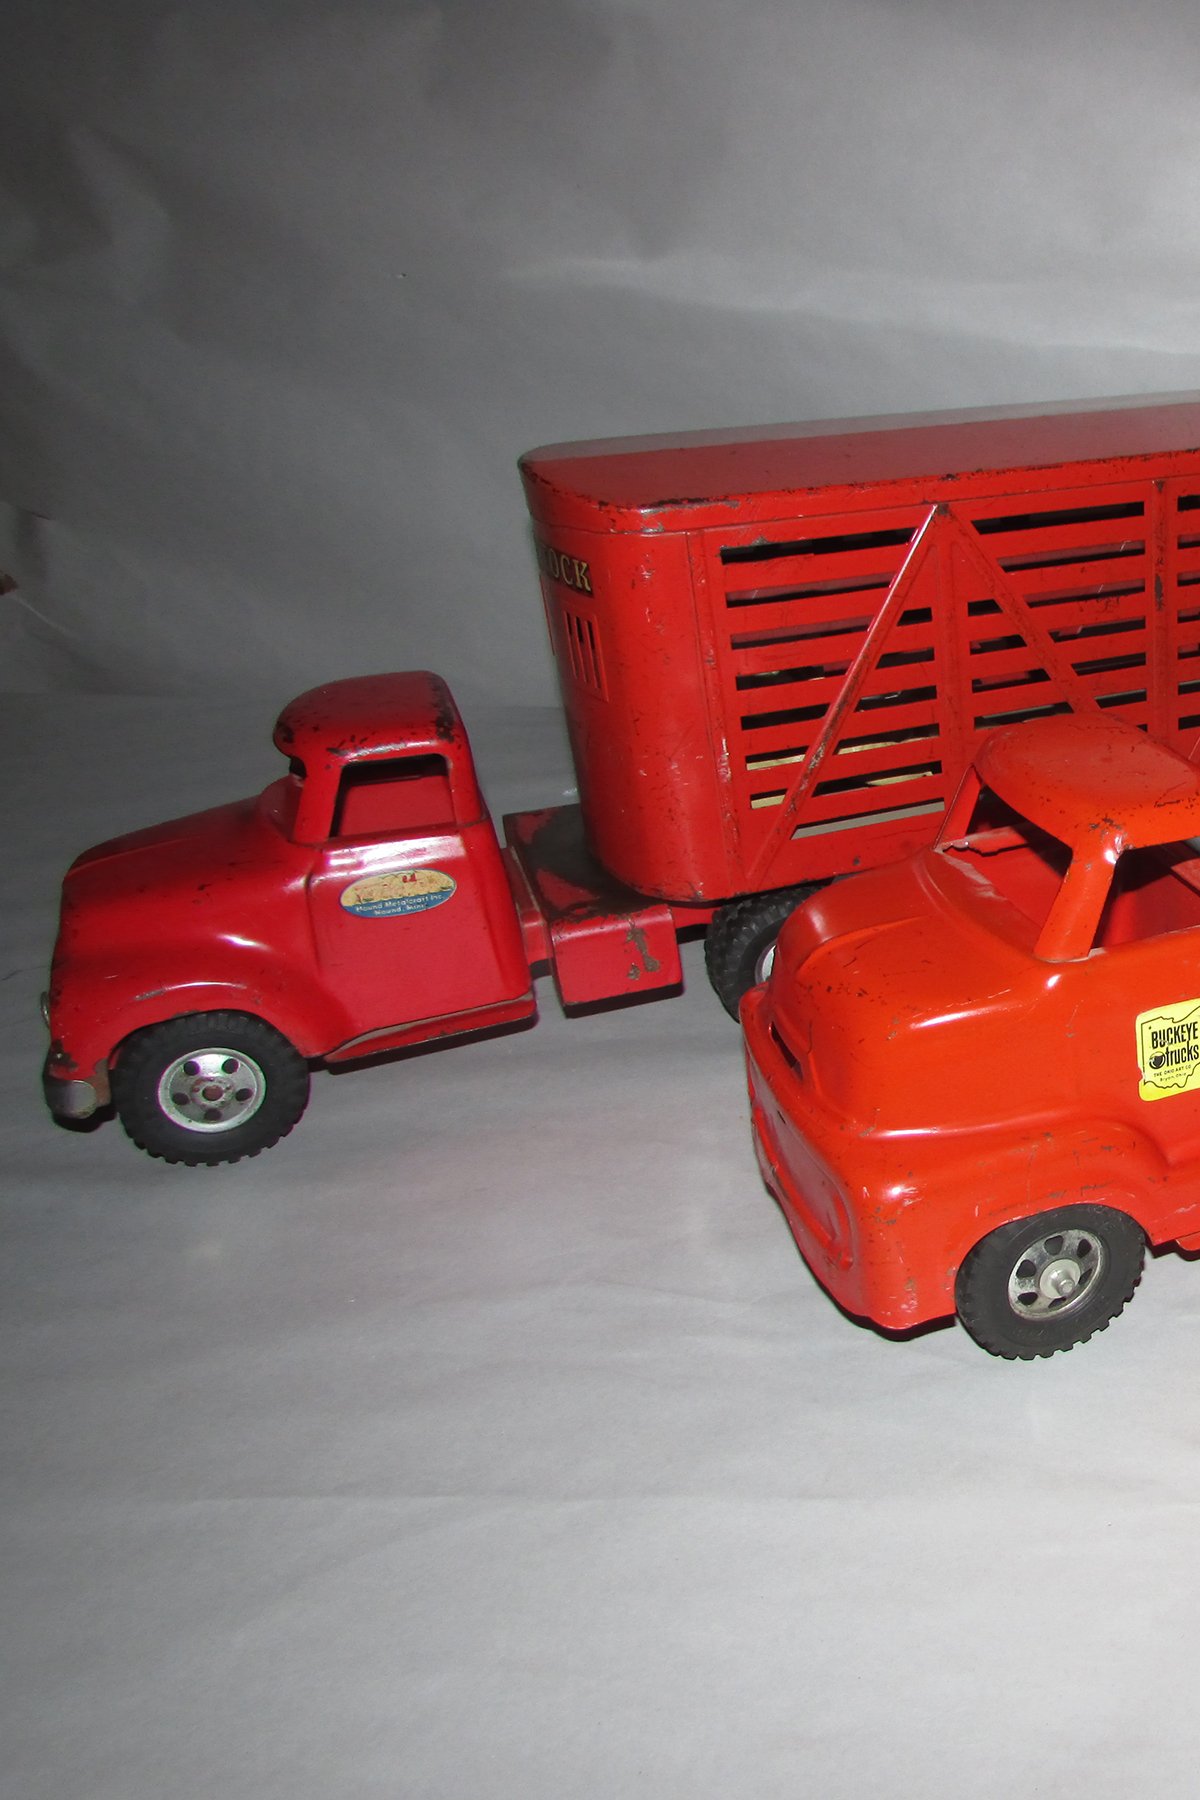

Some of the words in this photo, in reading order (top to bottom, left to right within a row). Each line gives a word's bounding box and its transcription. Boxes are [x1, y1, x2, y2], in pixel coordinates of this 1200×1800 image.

[543, 545, 592, 593] OCK
[384, 896, 428, 907] Metalcraft
[1151, 1021, 1198, 1049] BUCKEYE
